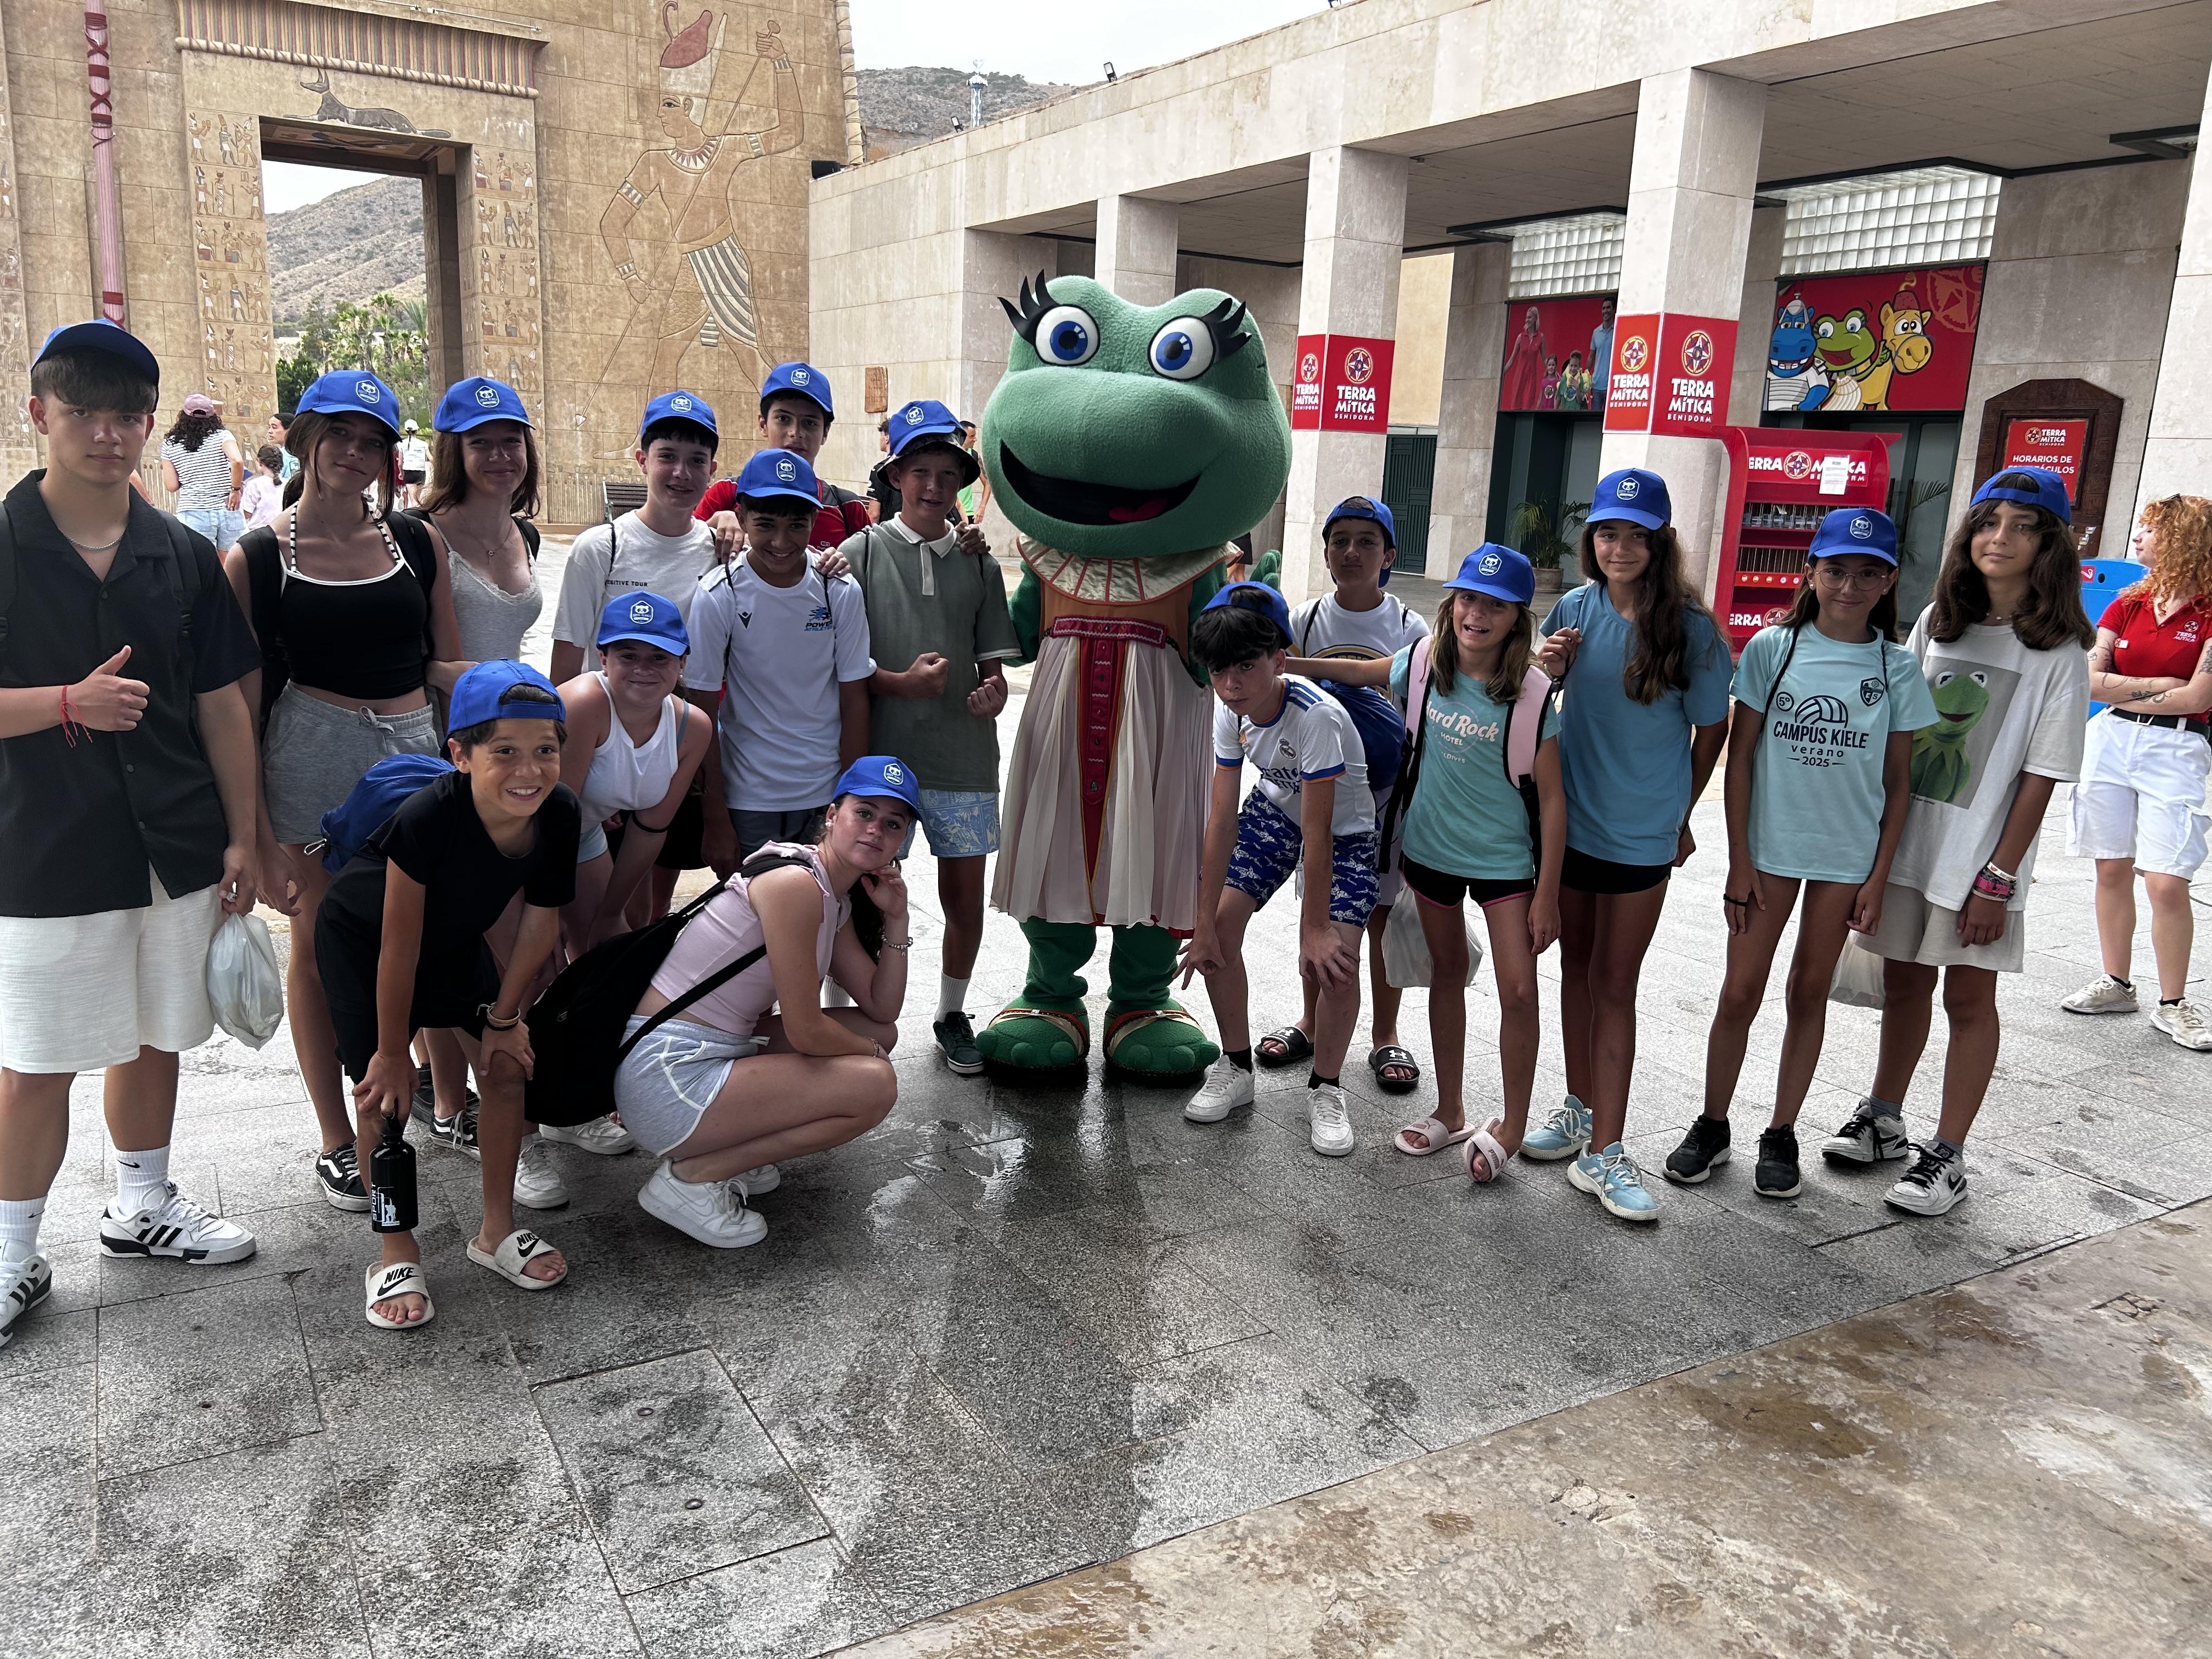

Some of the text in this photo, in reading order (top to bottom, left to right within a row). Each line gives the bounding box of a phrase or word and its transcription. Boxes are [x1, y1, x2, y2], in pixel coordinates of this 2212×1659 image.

[1613, 374, 1649, 388] TERRA
[1671, 378, 1714, 398] TERRA
[1296, 383, 1319, 395] TERRA
[1337, 386, 1375, 401] TERRA
[1667, 413, 1712, 423] BENIDORM
[1454, 715, 1499, 742] Rock
[1774, 720, 1869, 749] CAMPUS KIELE
[1441, 732, 1463, 746] HOTEL
[1791, 745, 1844, 758] verano
[1802, 756, 1830, 767] 2025
[384, 1267, 415, 1284] NIKE
